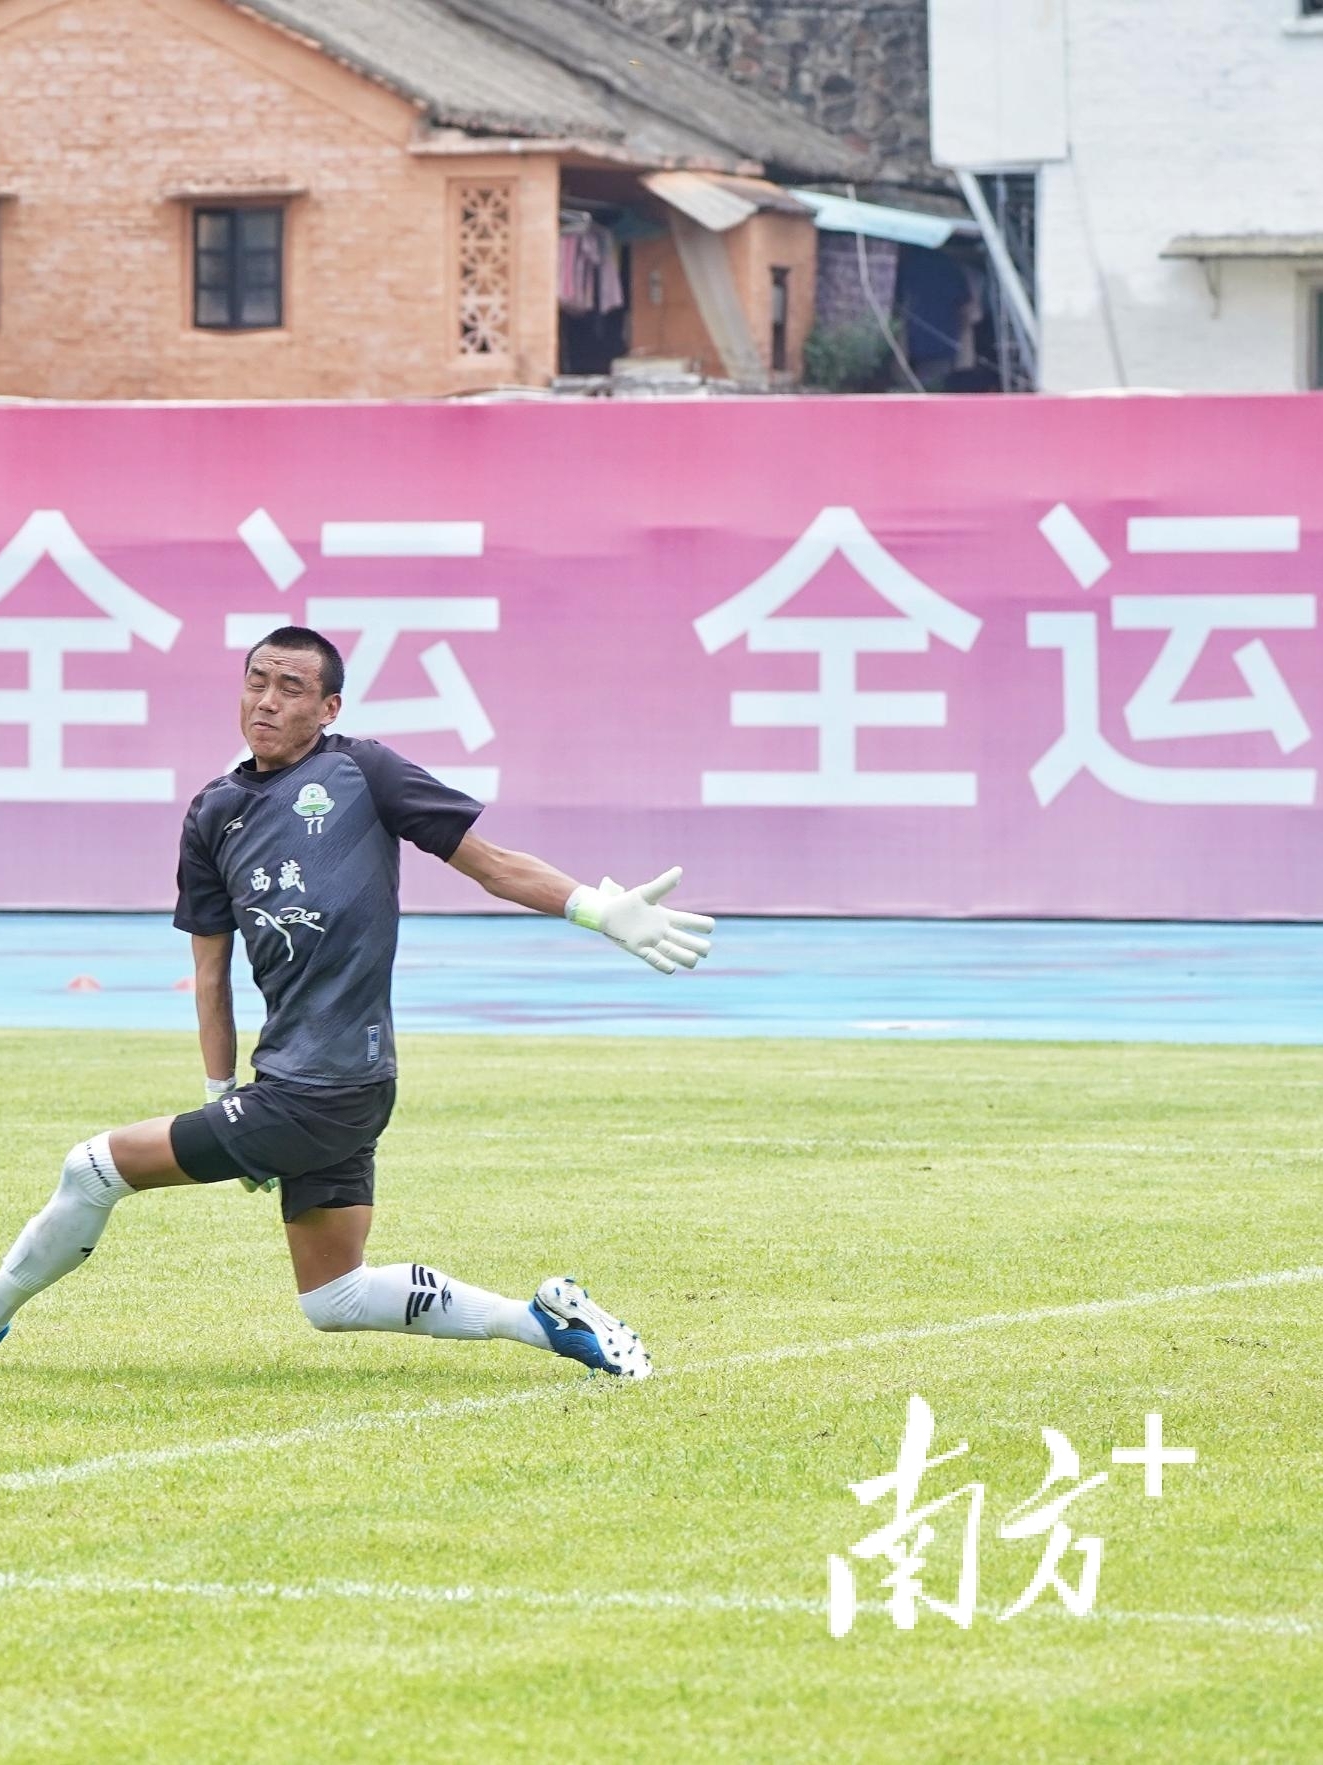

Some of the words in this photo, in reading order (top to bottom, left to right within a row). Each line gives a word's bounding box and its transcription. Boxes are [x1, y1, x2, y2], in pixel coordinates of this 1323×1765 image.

[693, 502, 1318, 808] 全运
[303, 816, 325, 835] 77
[250, 859, 306, 893] 西藏
